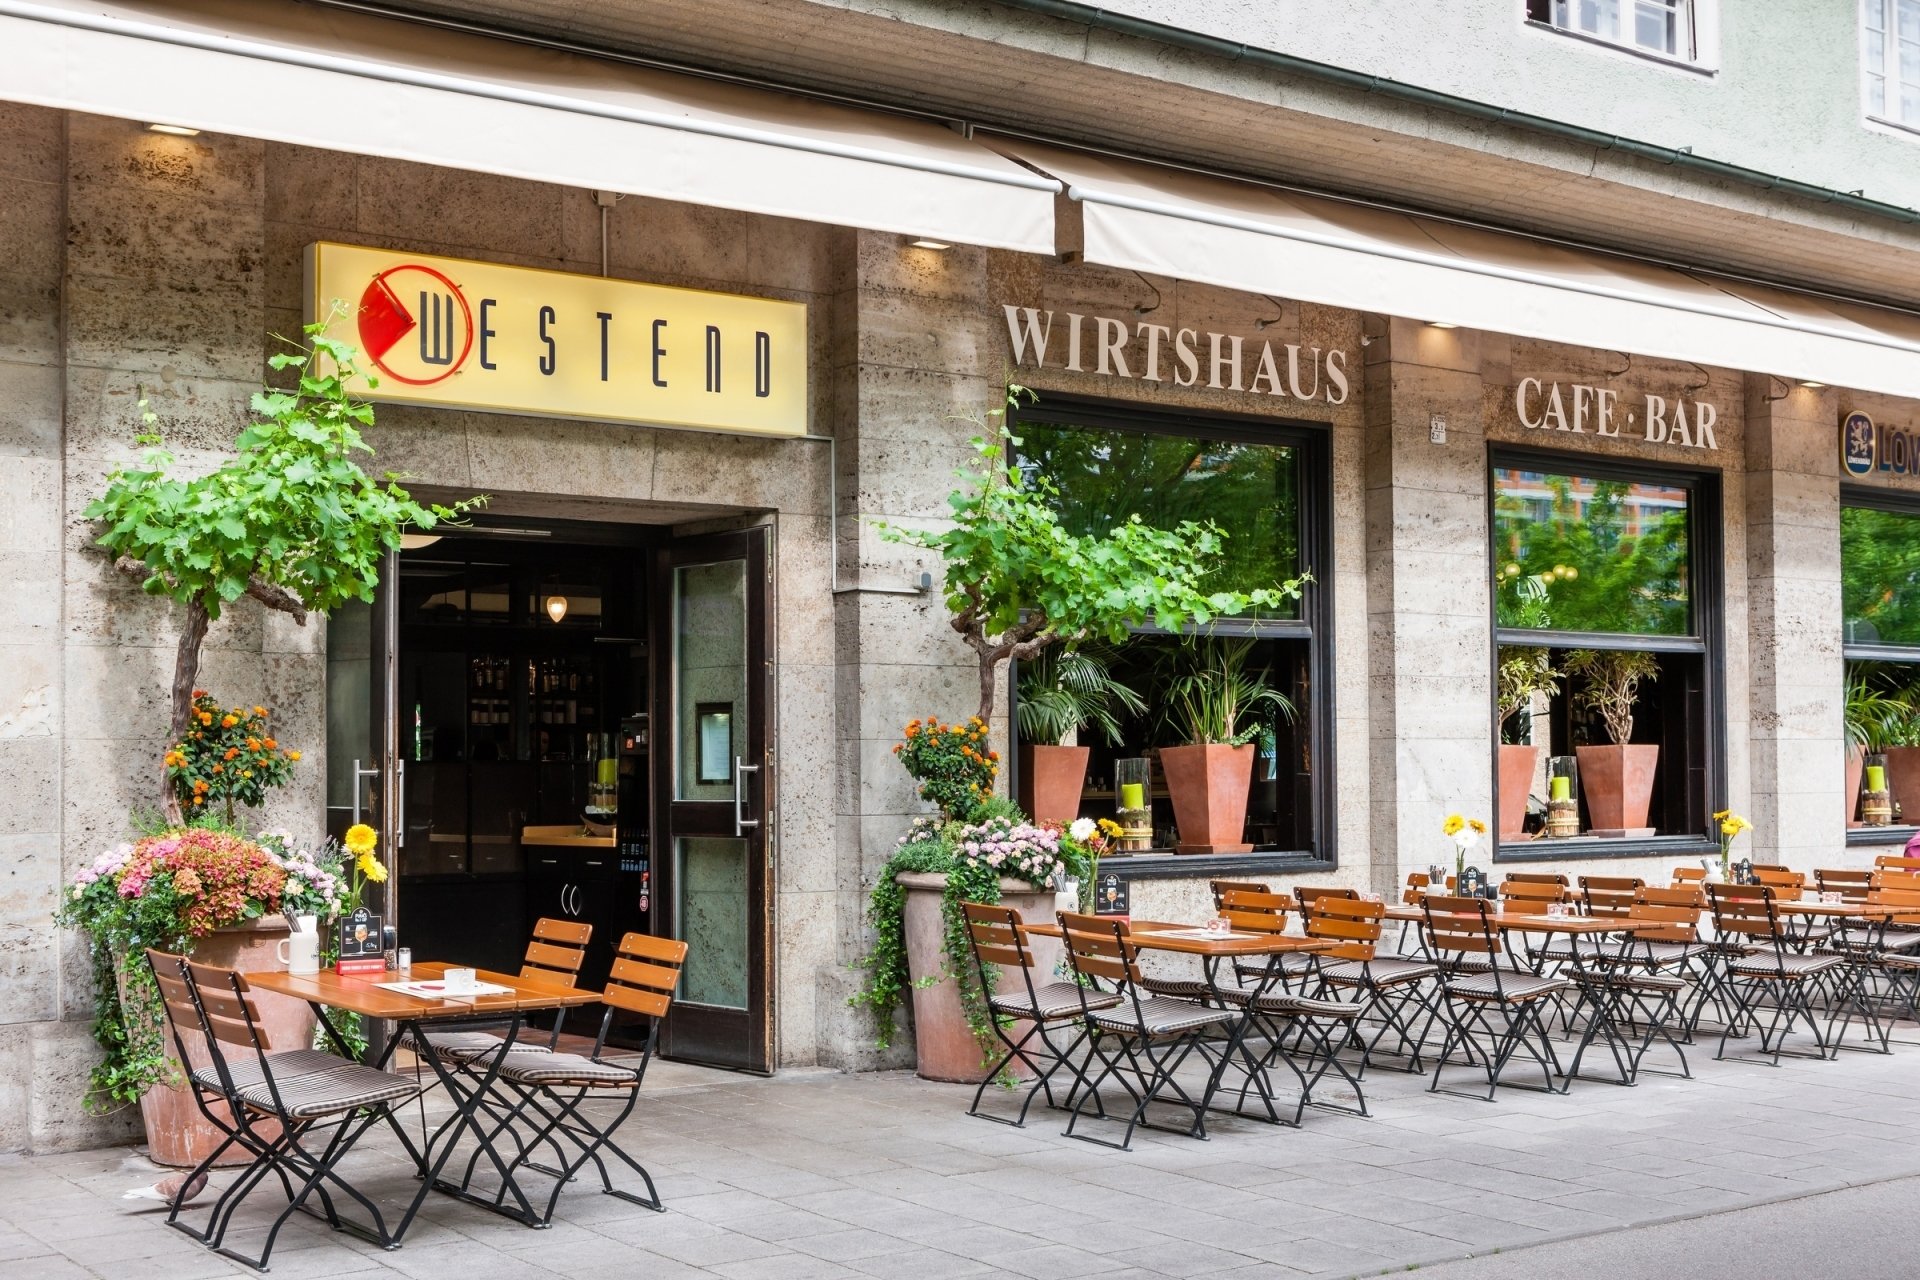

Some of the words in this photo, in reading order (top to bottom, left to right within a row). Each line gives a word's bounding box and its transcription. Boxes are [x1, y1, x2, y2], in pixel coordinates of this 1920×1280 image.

[420, 291, 770, 398] WESTEND
[1002, 304, 1350, 405] WIRTSHAUS
[1516, 376, 1619, 437] CAFE
[1644, 394, 1718, 450] BAR
